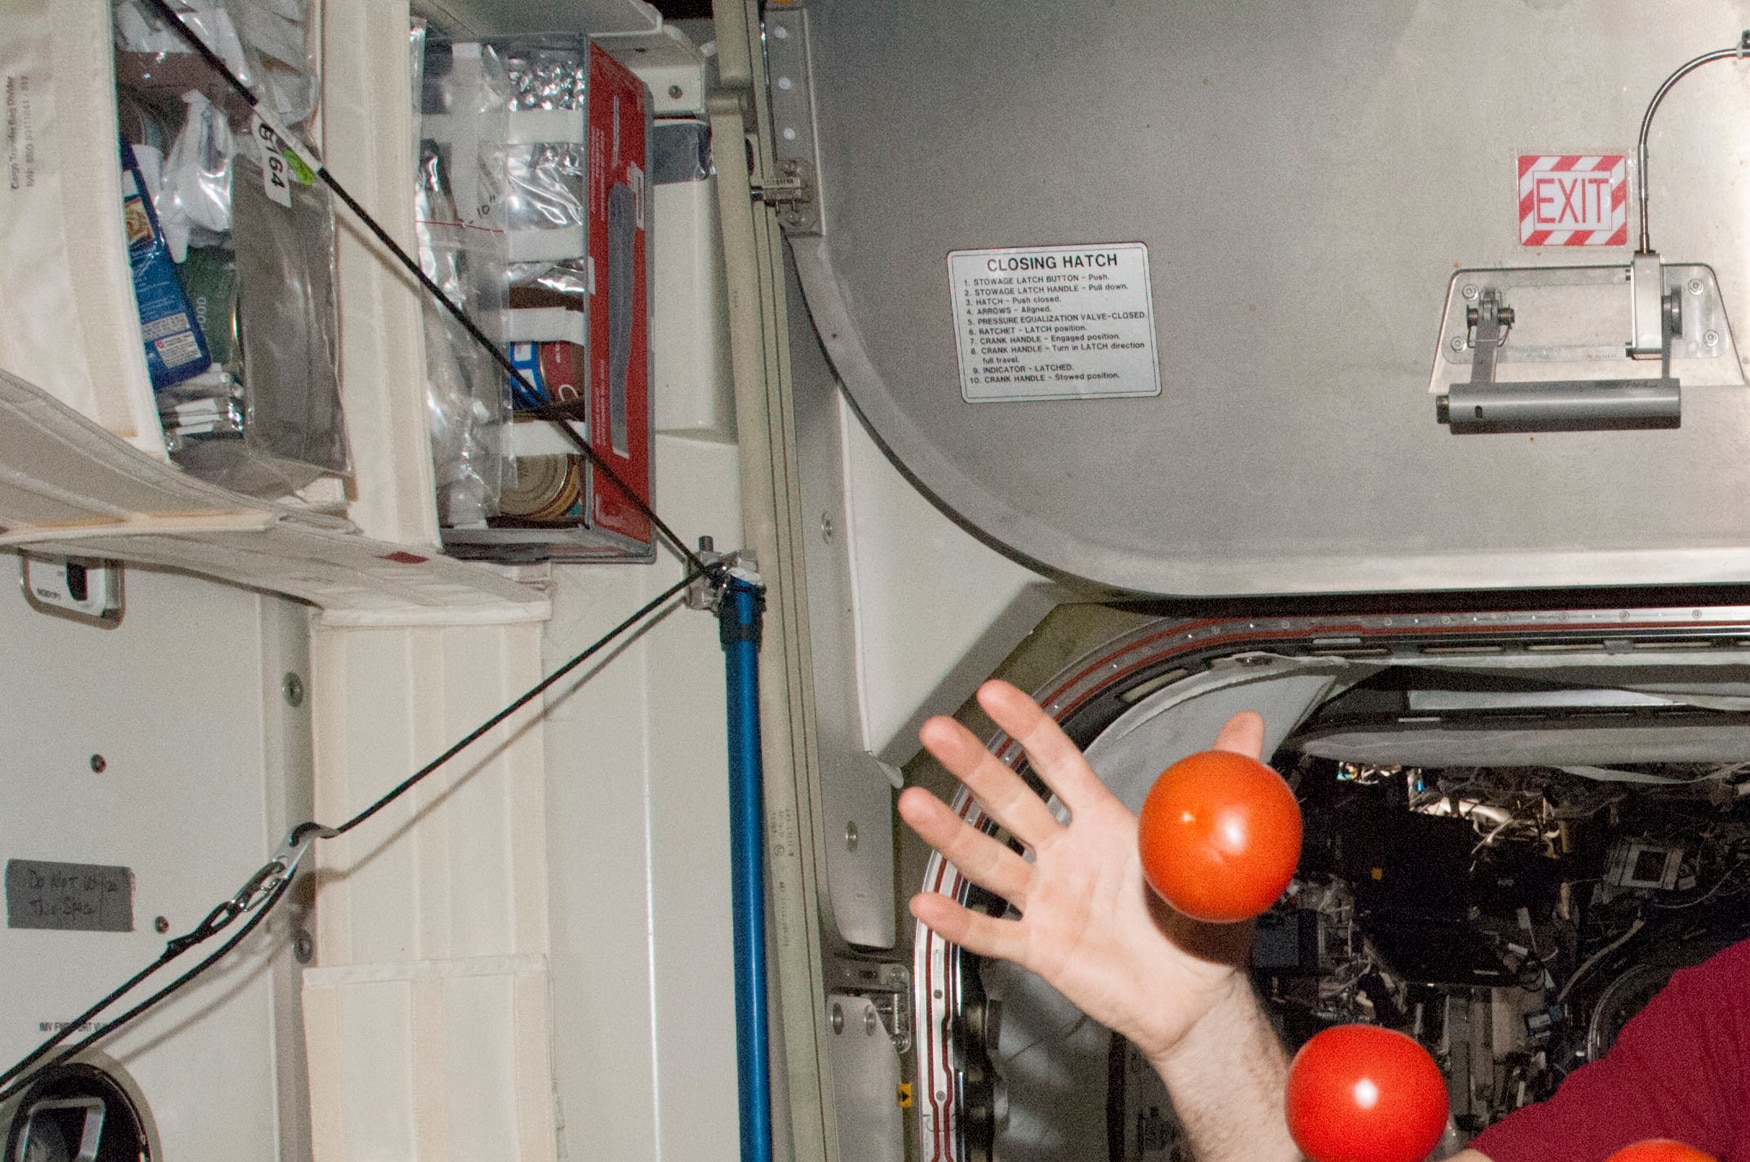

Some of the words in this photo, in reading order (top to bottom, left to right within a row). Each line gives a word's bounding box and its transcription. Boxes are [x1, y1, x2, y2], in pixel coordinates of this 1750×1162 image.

[258, 122, 286, 188] B164
[1536, 178, 1608, 223] EXIT
[987, 256, 1057, 271] CLOSING
[1063, 254, 1118, 268] HATCH
[974, 277, 1013, 286] STOWAGE
[1017, 276, 1043, 284] LATCH
[1046, 275, 1079, 283] BUTTON
[975, 287, 1015, 296] STOWAGE
[1018, 286, 1044, 294] LATCH
[1047, 284, 1078, 293] HANDLE
[1012, 296, 1031, 304] Push
[977, 306, 1011, 315] ARROWS
[978, 316, 1018, 325] PRESSURE
[1021, 314, 1078, 323] EQUALIZATION
[979, 326, 1015, 335] RATCHET
[1025, 325, 1051, 333] LATCH
[980, 337, 1007, 345] CRANK
[1010, 335, 1041, 343] HANDLE
[1051, 334, 1085, 343] Engaged
[981, 346, 1009, 355] CRANK
[1011, 345, 1042, 353] HANDLE
[1081, 342, 1108, 350] LATCH
[1110, 341, 1145, 349] direction
[983, 365, 1026, 373] INDICATOR
[984, 375, 1011, 383] CRANK
[1014, 374, 1045, 382] HANDLE
[1055, 373, 1084, 381] Stowed
